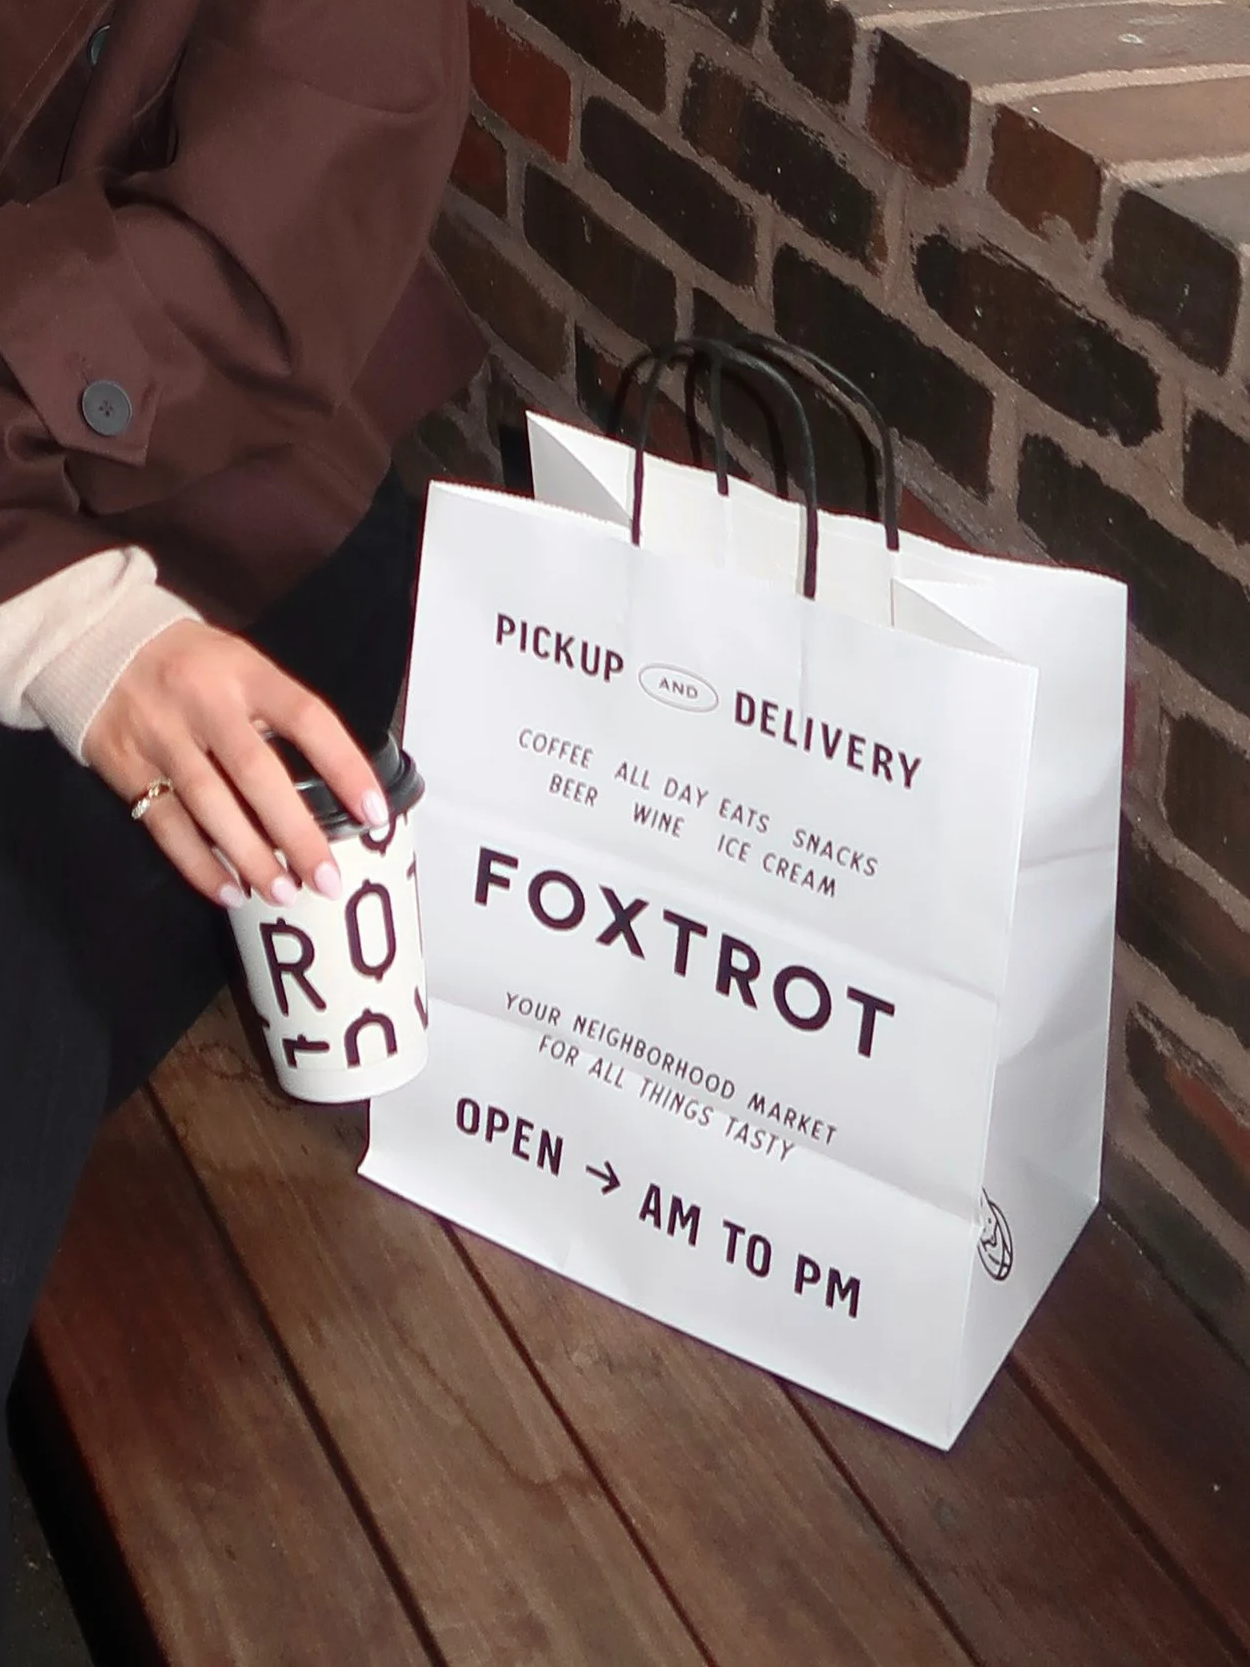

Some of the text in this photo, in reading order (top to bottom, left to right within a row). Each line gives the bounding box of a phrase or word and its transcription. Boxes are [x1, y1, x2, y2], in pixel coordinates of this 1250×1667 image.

[496, 612, 922, 789] PICKUP AND DELIVERY
[519, 729, 879, 877] COFFEE ALL DAY EATS SNACKS
[549, 774, 837, 898] BEER WINE ICE CREAM
[474, 846, 896, 1059] FOXTROT
[506, 991, 837, 1145] YOUR NEIGHBORHOOD MARKET
[539, 1034, 796, 1162] FOR ALL THINGS TASTY
[456, 1097, 860, 1319] OPEN AM TO PM
